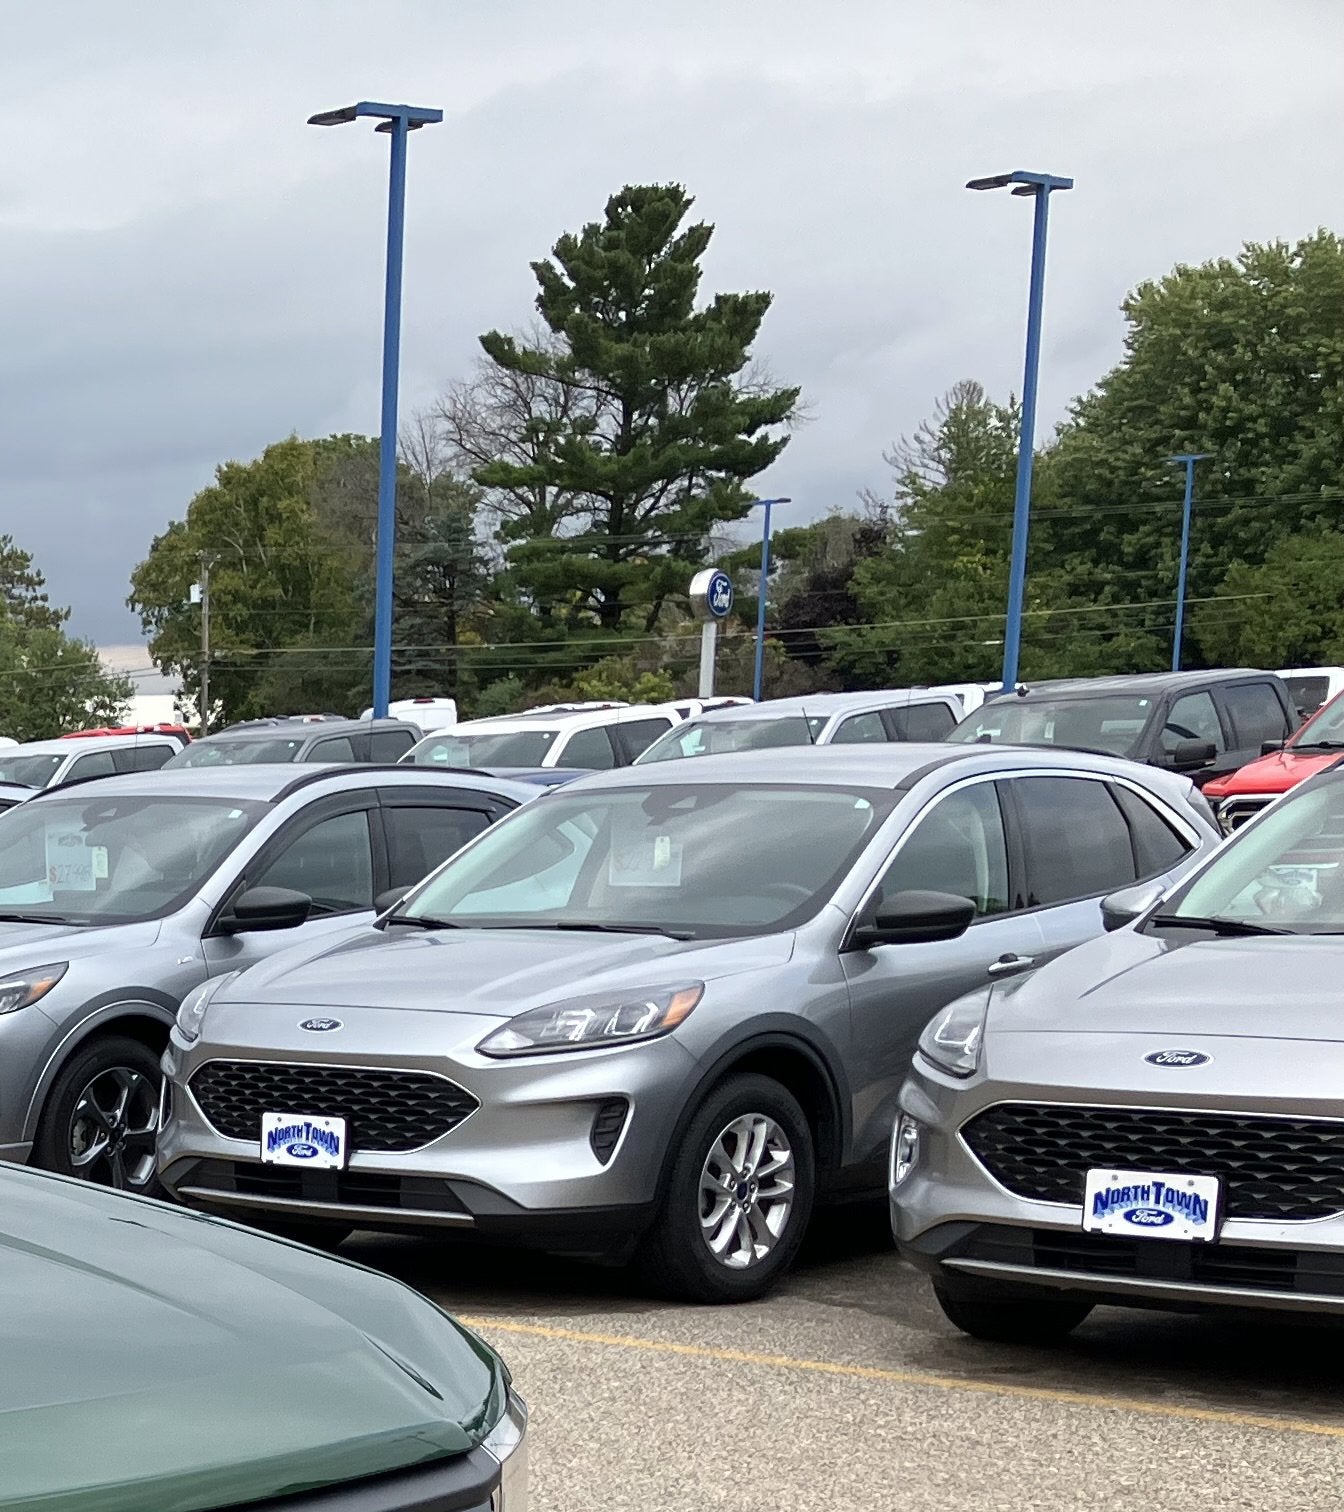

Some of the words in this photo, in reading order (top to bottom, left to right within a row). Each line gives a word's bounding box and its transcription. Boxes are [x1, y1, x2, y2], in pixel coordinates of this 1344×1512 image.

[1155, 1051, 1198, 1064] Ford
[292, 1145, 313, 1157] Ford
[1132, 1210, 1165, 1225] Ford
